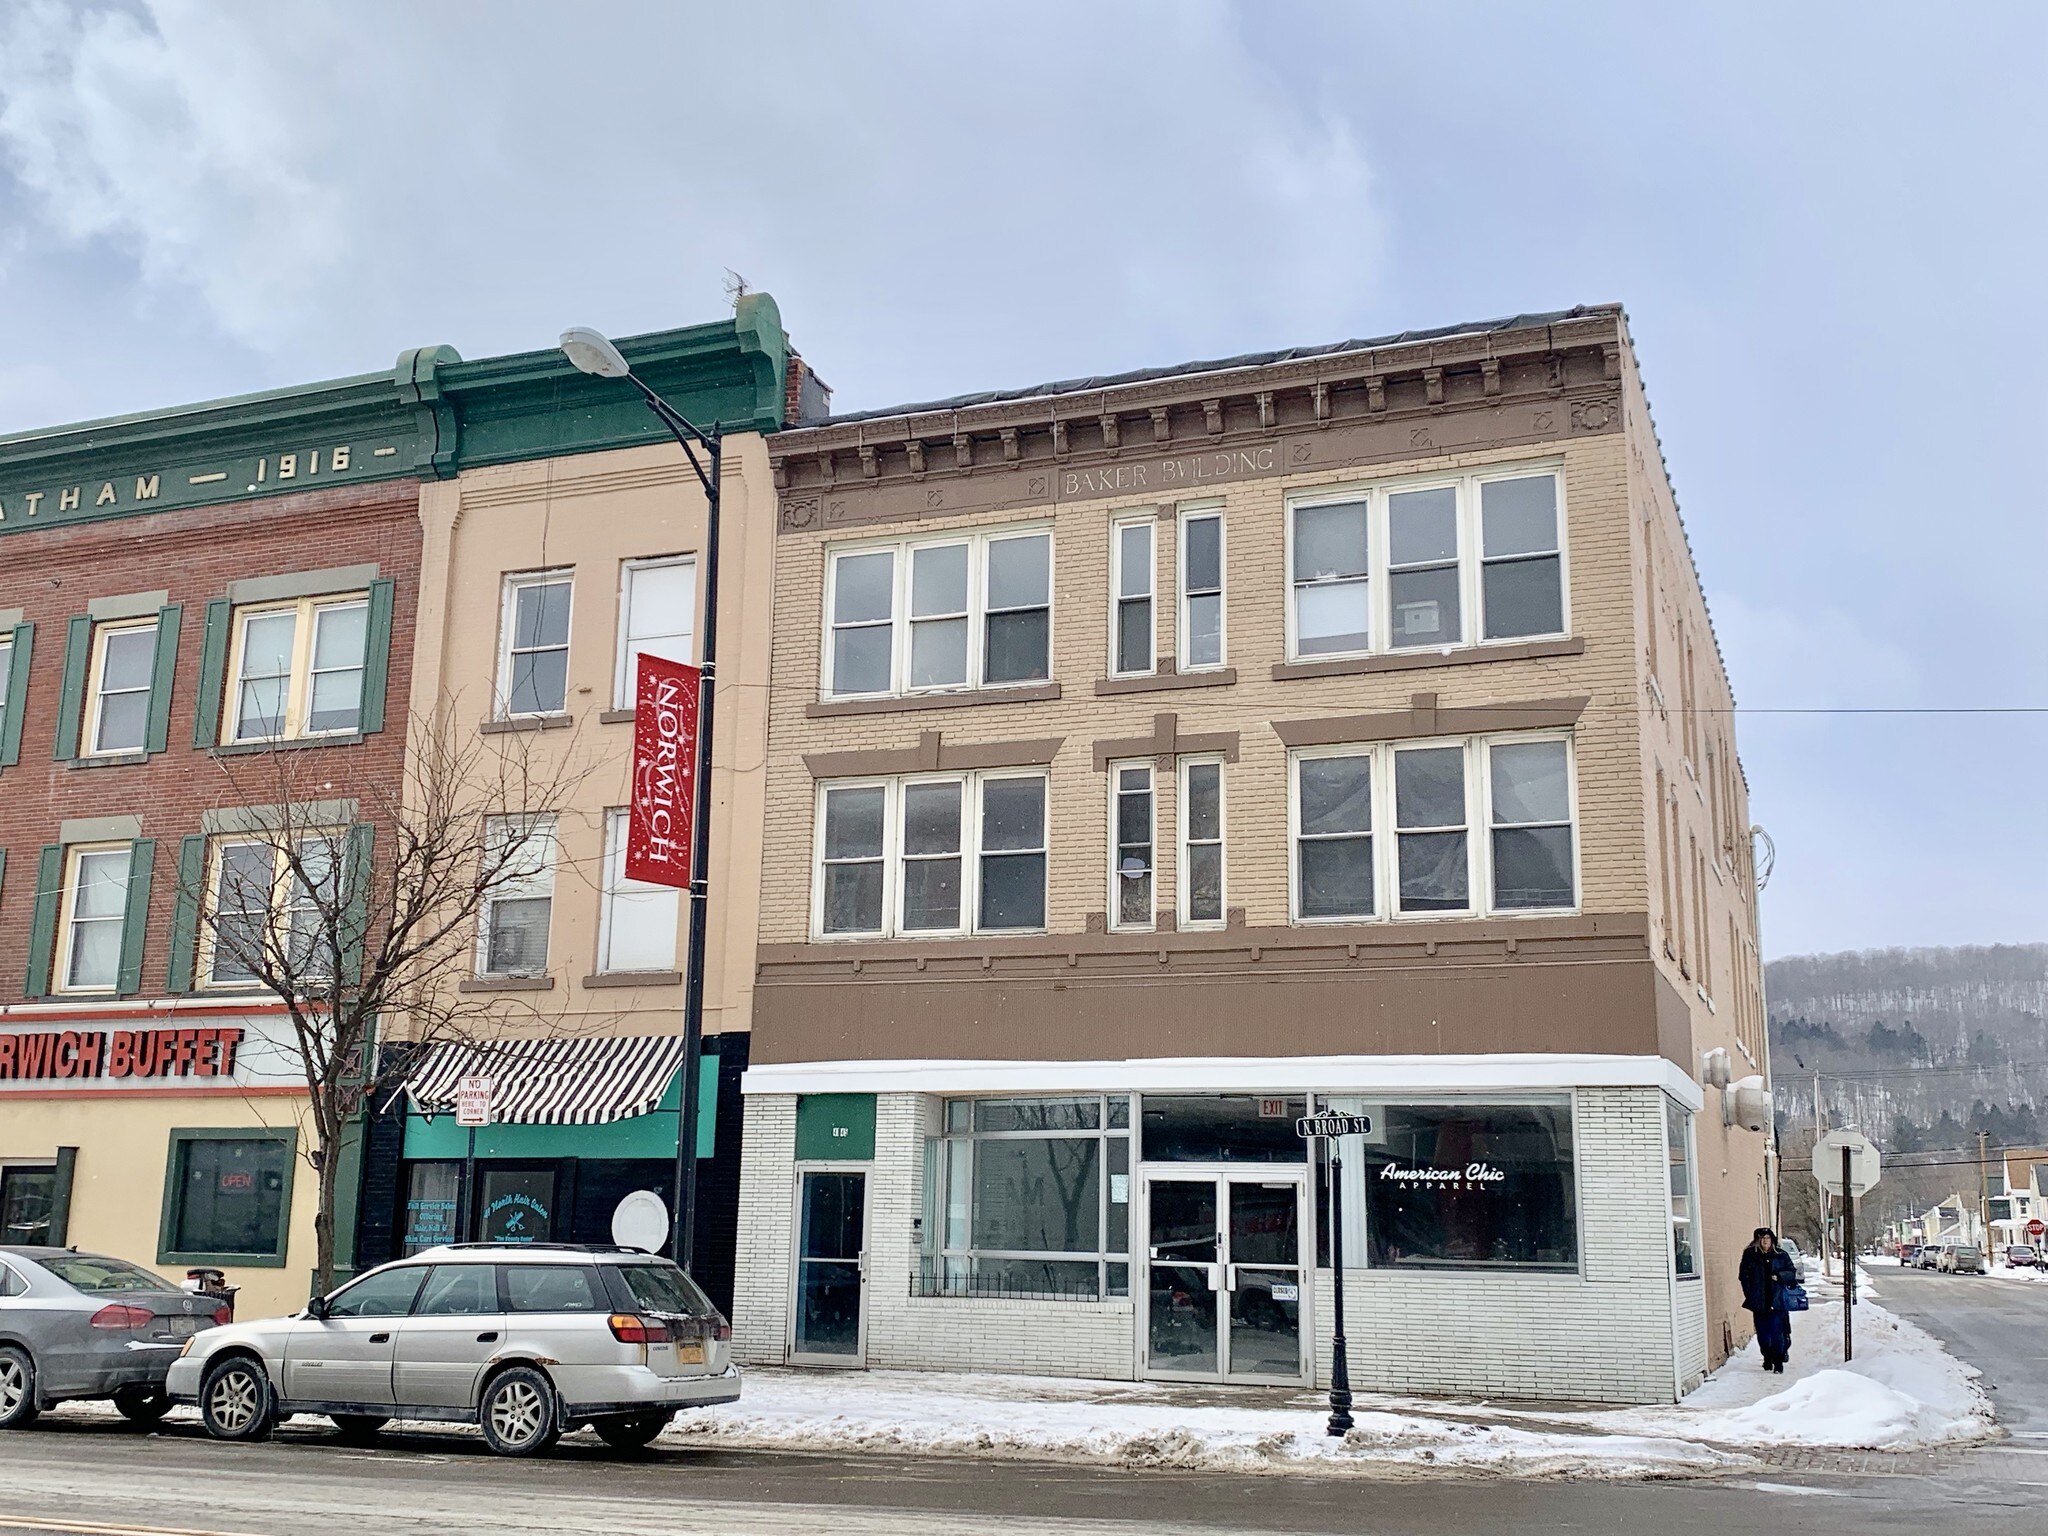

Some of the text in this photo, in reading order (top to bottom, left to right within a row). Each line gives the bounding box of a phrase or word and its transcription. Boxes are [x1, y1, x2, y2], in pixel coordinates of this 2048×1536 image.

[0, 445, 350, 521] THAM 1916
[1065, 464, 1148, 495] BAKER
[648, 682, 679, 864] NORWICH
[0, 1028, 245, 1079] RWICH BUFFET
[468, 1079, 481, 1089] NO
[460, 1090, 489, 1100] PARKING
[1263, 1100, 1283, 1116] EXIT
[1315, 1118, 1349, 1136] BROAD
[1354, 1117, 1368, 1133] ST.
[1380, 1162, 1505, 1181] American Chic
[222, 1174, 251, 1187] OPEN
[1399, 1182, 1486, 1191] APPAREL
[2027, 1223, 2045, 1231] STOP
